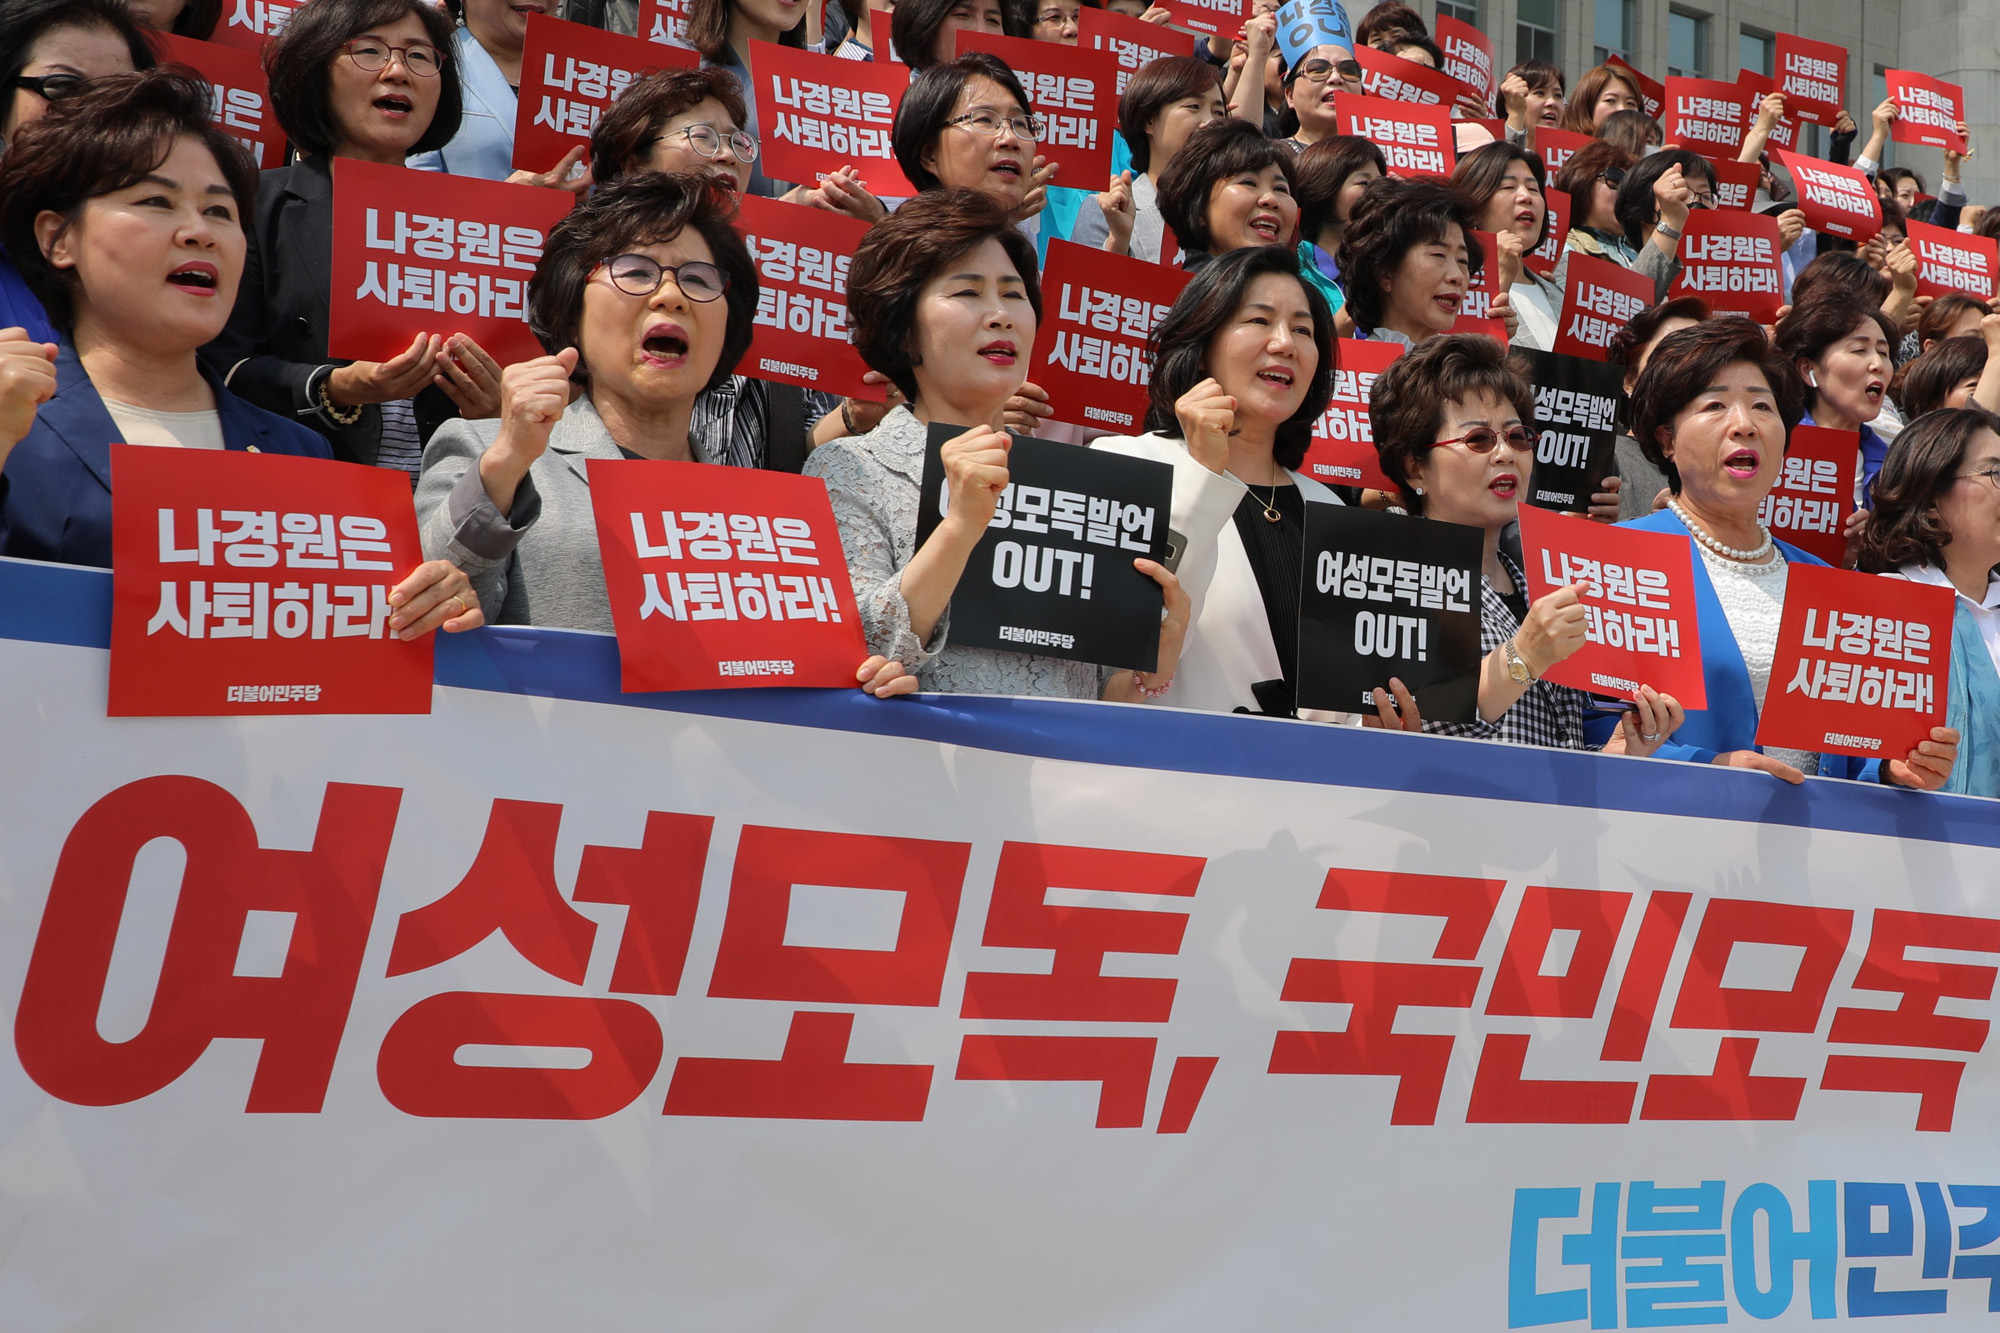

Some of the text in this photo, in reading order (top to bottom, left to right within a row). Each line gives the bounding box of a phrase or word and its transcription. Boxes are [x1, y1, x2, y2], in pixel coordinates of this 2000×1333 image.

[1444, 35, 1490, 76] 나경원은
[1785, 53, 1839, 83] 나경원은
[772, 74, 893, 124] 나경원은
[1782, 75, 1840, 105] 사퇴하라!
[1898, 86, 1954, 116] 나경원은
[1677, 96, 1742, 123] 나경원은
[773, 111, 899, 160] 사퇴하라
[1350, 115, 1439, 147] 나경원은
[1674, 119, 1741, 147] 사퇴하라!
[1796, 165, 1867, 196] 나경원은
[1805, 184, 1875, 218] 사퇴하라!
[365, 207, 545, 272] 나경원은
[1686, 235, 1774, 264] 나경원은
[1919, 240, 1988, 273] 나경원은
[1681, 266, 1779, 293] 사퇴하라!
[1919, 266, 1993, 296] 사퇴하라!
[760, 358, 819, 381] 더불어민주당
[1084, 406, 1133, 426] 더불어민주당
[1529, 384, 1617, 432] 성모독발언
[1537, 430, 1591, 469] OUT!
[1313, 463, 1362, 480] 더불어민주당
[158, 508, 393, 571] 나경원은
[630, 511, 820, 565] 나경원은
[992, 541, 1095, 600] OUT!
[1316, 550, 1471, 613] 여성모독발언
[1541, 548, 1671, 610] 나경원은
[147, 581, 401, 640] 사퇴하라
[640, 572, 843, 623] 사퇴하라!
[999, 626, 1076, 650] 더불어민주당
[1354, 610, 1428, 662] OUT!
[1802, 608, 1931, 665] 나경원은
[718, 660, 795, 676] 더불어민주당
[1591, 672, 1639, 692] 더불어민주당
[227, 685, 321, 702] 더불어민주당
[1786, 657, 1934, 714] 사퇴하라!
[1823, 732, 1883, 750] 더불어민주당
[14, 774, 2000, 1136] 여성모독, 국민모독
